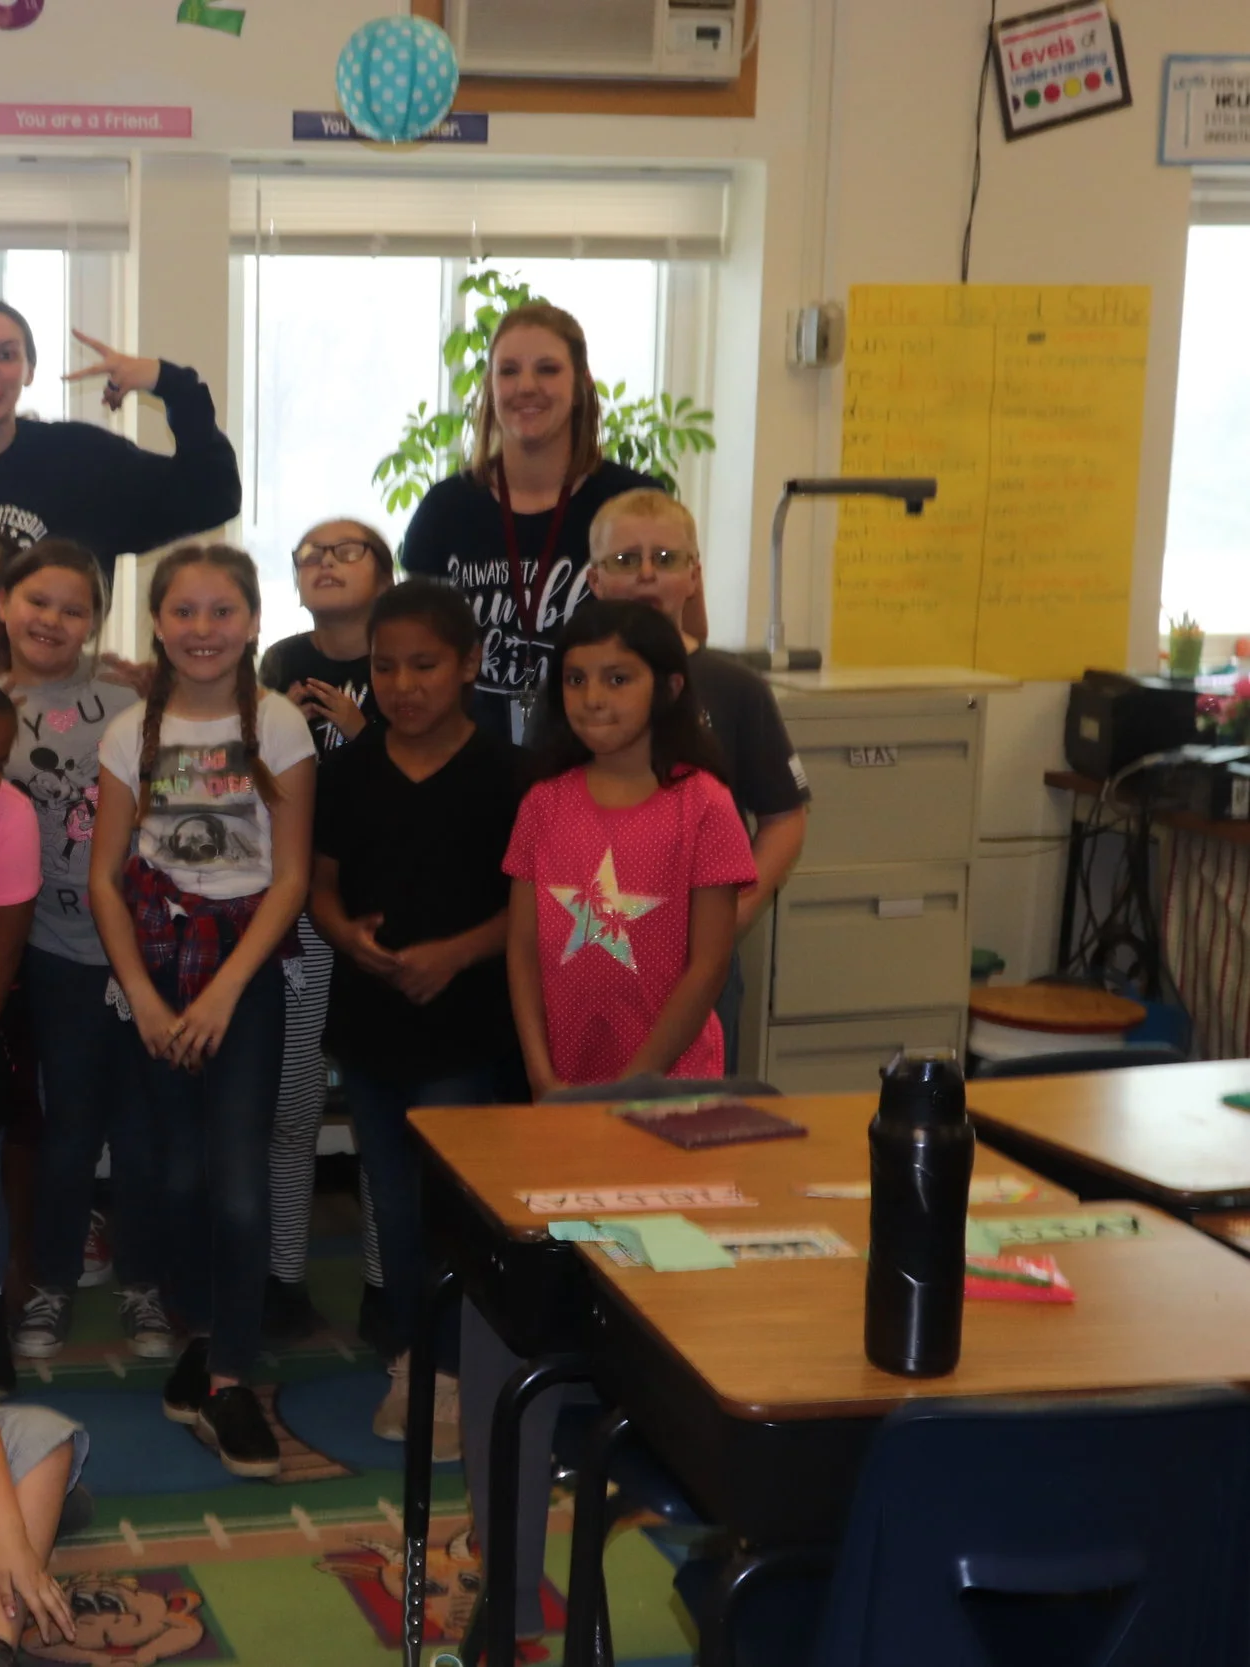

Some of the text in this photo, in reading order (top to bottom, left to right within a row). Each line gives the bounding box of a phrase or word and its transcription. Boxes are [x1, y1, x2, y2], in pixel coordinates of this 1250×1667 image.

[1009, 29, 1096, 71] Levels of
[16, 110, 163, 130] You are a friend.
[321, 115, 349, 136] You
[462, 560, 509, 588] ALWAYS
[481, 628, 549, 685] kin
[23, 695, 105, 741] Y U
